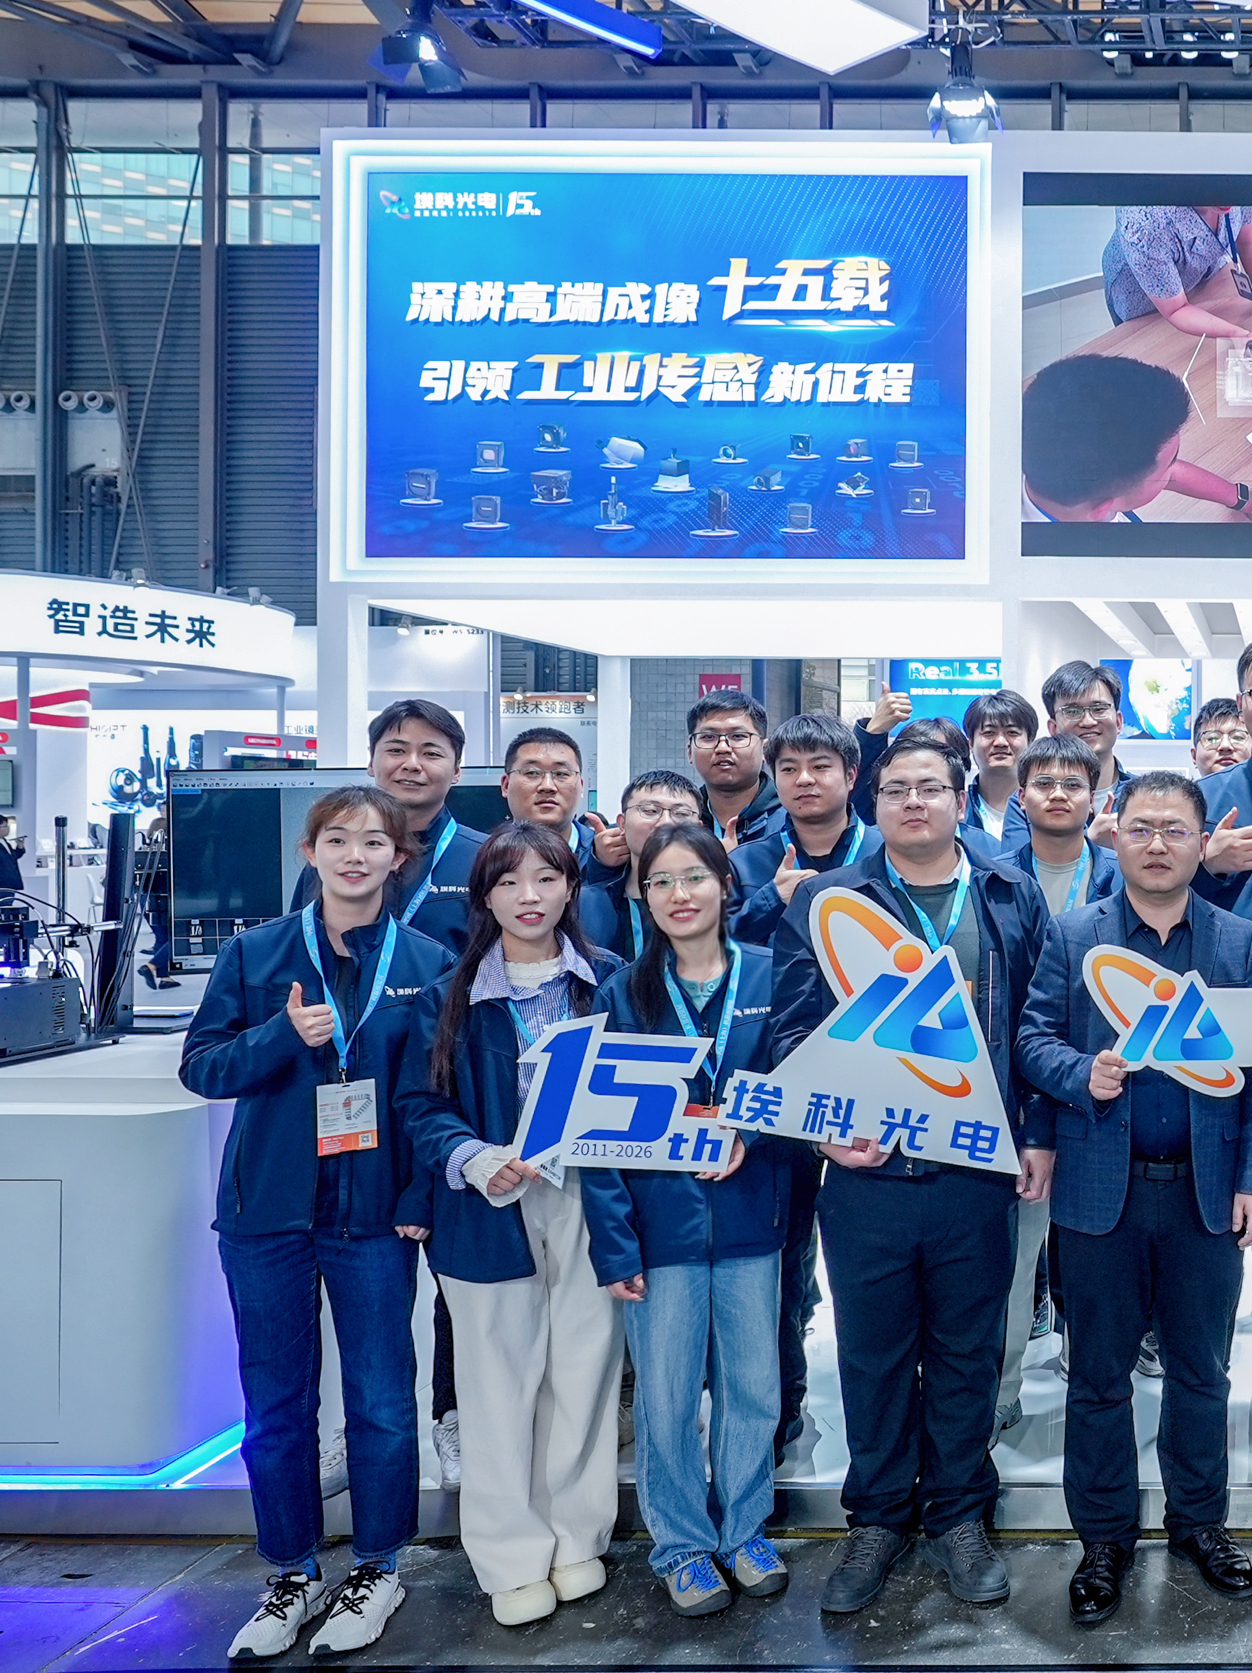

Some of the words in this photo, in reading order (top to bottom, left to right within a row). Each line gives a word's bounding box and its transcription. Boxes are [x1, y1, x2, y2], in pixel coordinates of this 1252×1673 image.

[405, 256, 892, 323] 深耕高端成像十五载
[419, 352, 914, 403] 引领工业传感新征程
[105, 458, 117, 468] 15
[47, 598, 216, 648] 智造未来
[965, 662, 1002, 681] 3.5
[727, 1079, 1000, 1163] 埃科光电
[571, 1142, 653, 1159] 2011-2026
